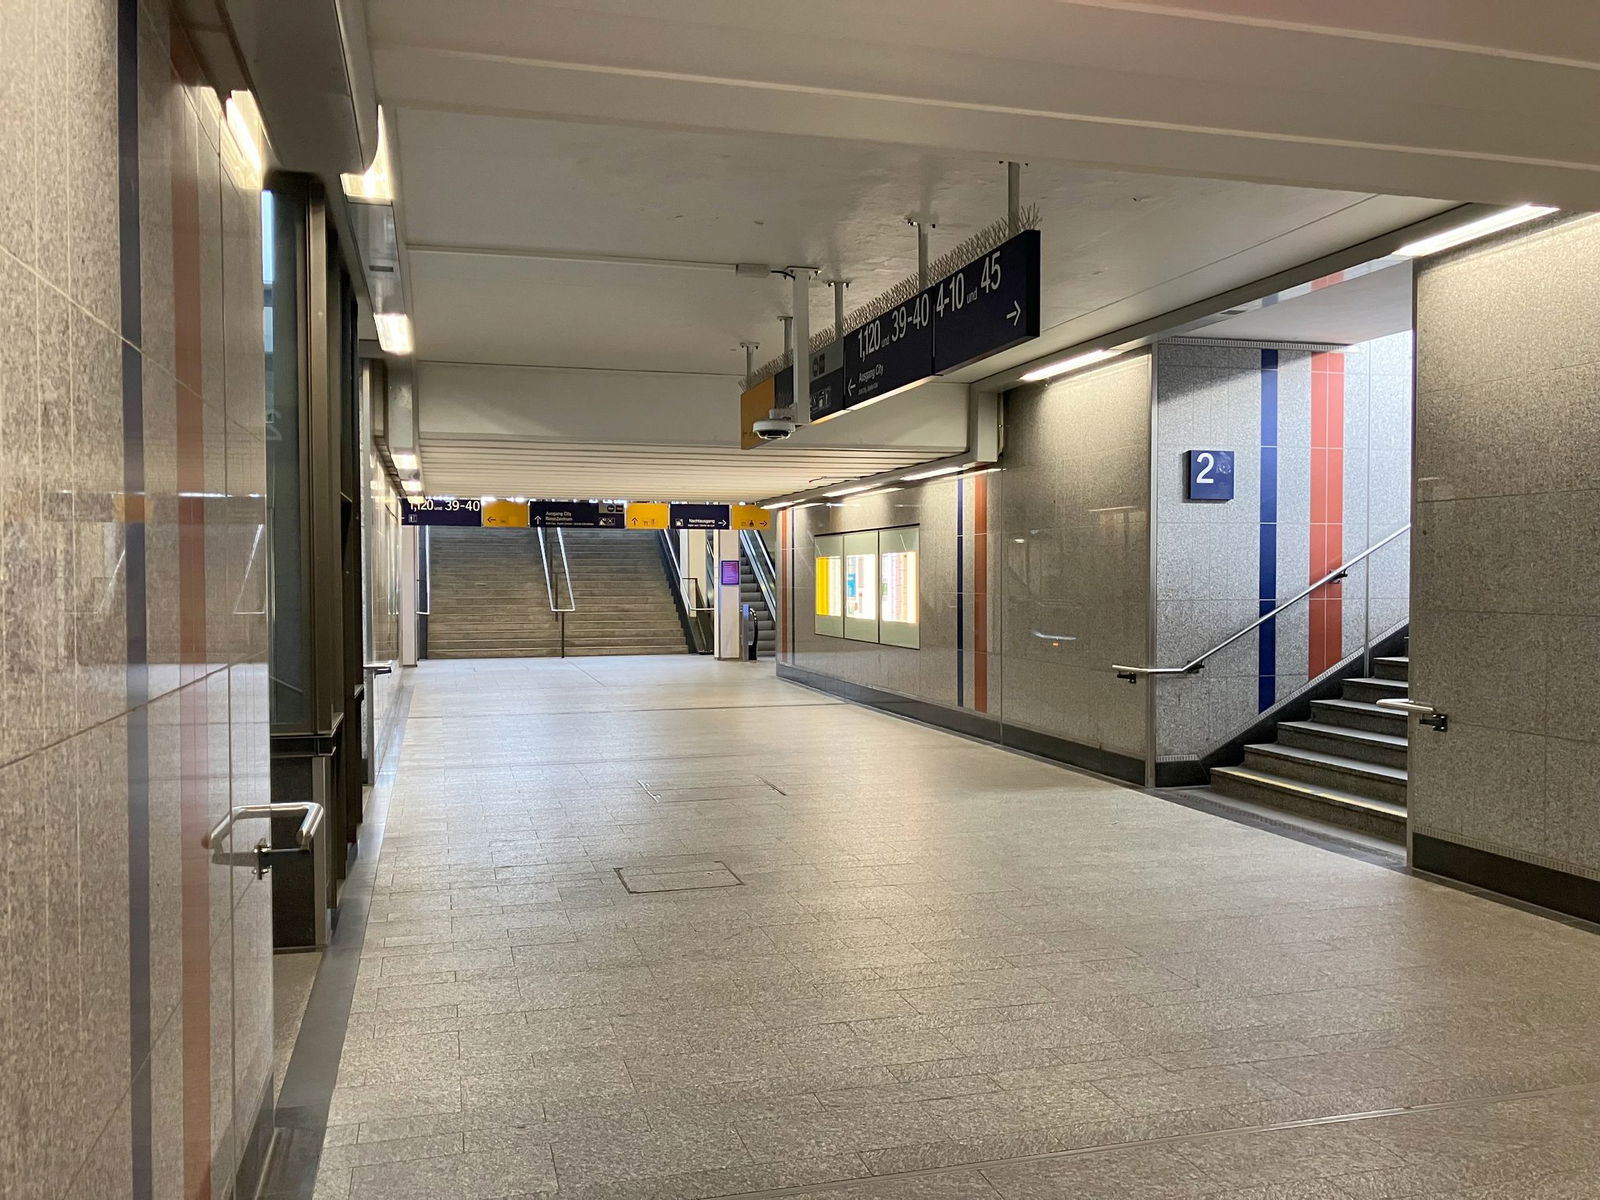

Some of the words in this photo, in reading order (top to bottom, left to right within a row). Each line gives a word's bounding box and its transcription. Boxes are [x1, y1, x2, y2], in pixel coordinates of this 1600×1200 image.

[936, 272, 965, 318] 4-10
[967, 286, 977, 304] und
[981, 251, 1001, 293] 45
[858, 320, 880, 362] 1,120
[881, 335, 890, 348] und
[892, 293, 929, 342] 39-40
[1196, 452, 1215, 484] 2
[444, 500, 480, 512] 39-40
